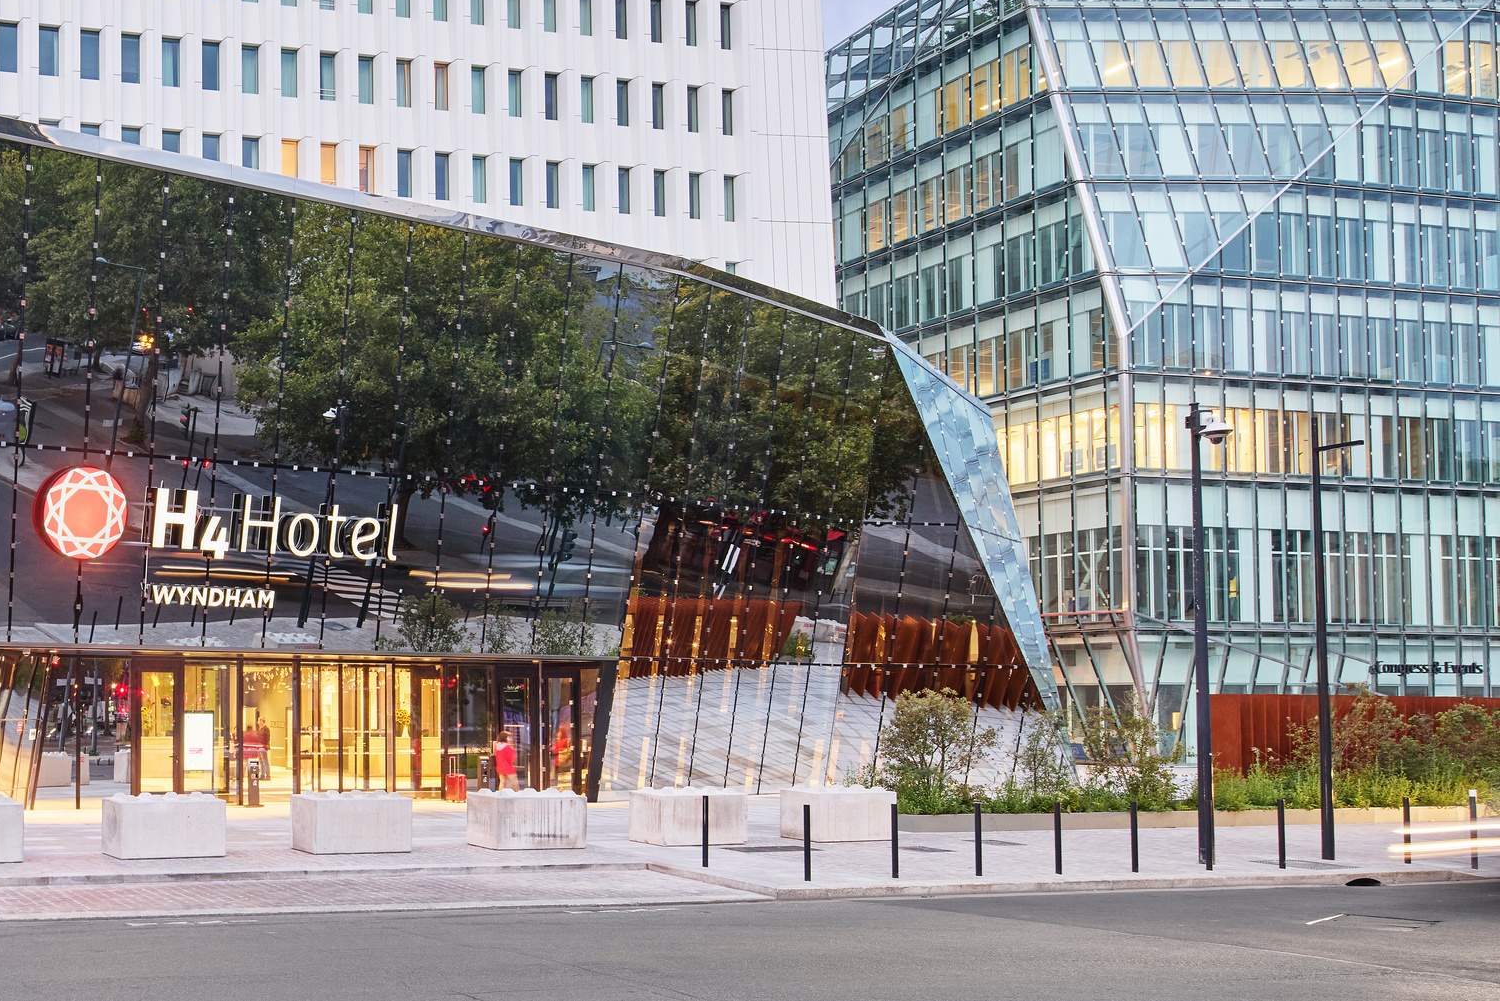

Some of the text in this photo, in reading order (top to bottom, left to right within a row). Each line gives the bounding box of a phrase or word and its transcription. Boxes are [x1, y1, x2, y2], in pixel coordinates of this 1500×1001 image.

[151, 487, 399, 561] H4 Hotel
[152, 584, 276, 609] WYNDHAM
